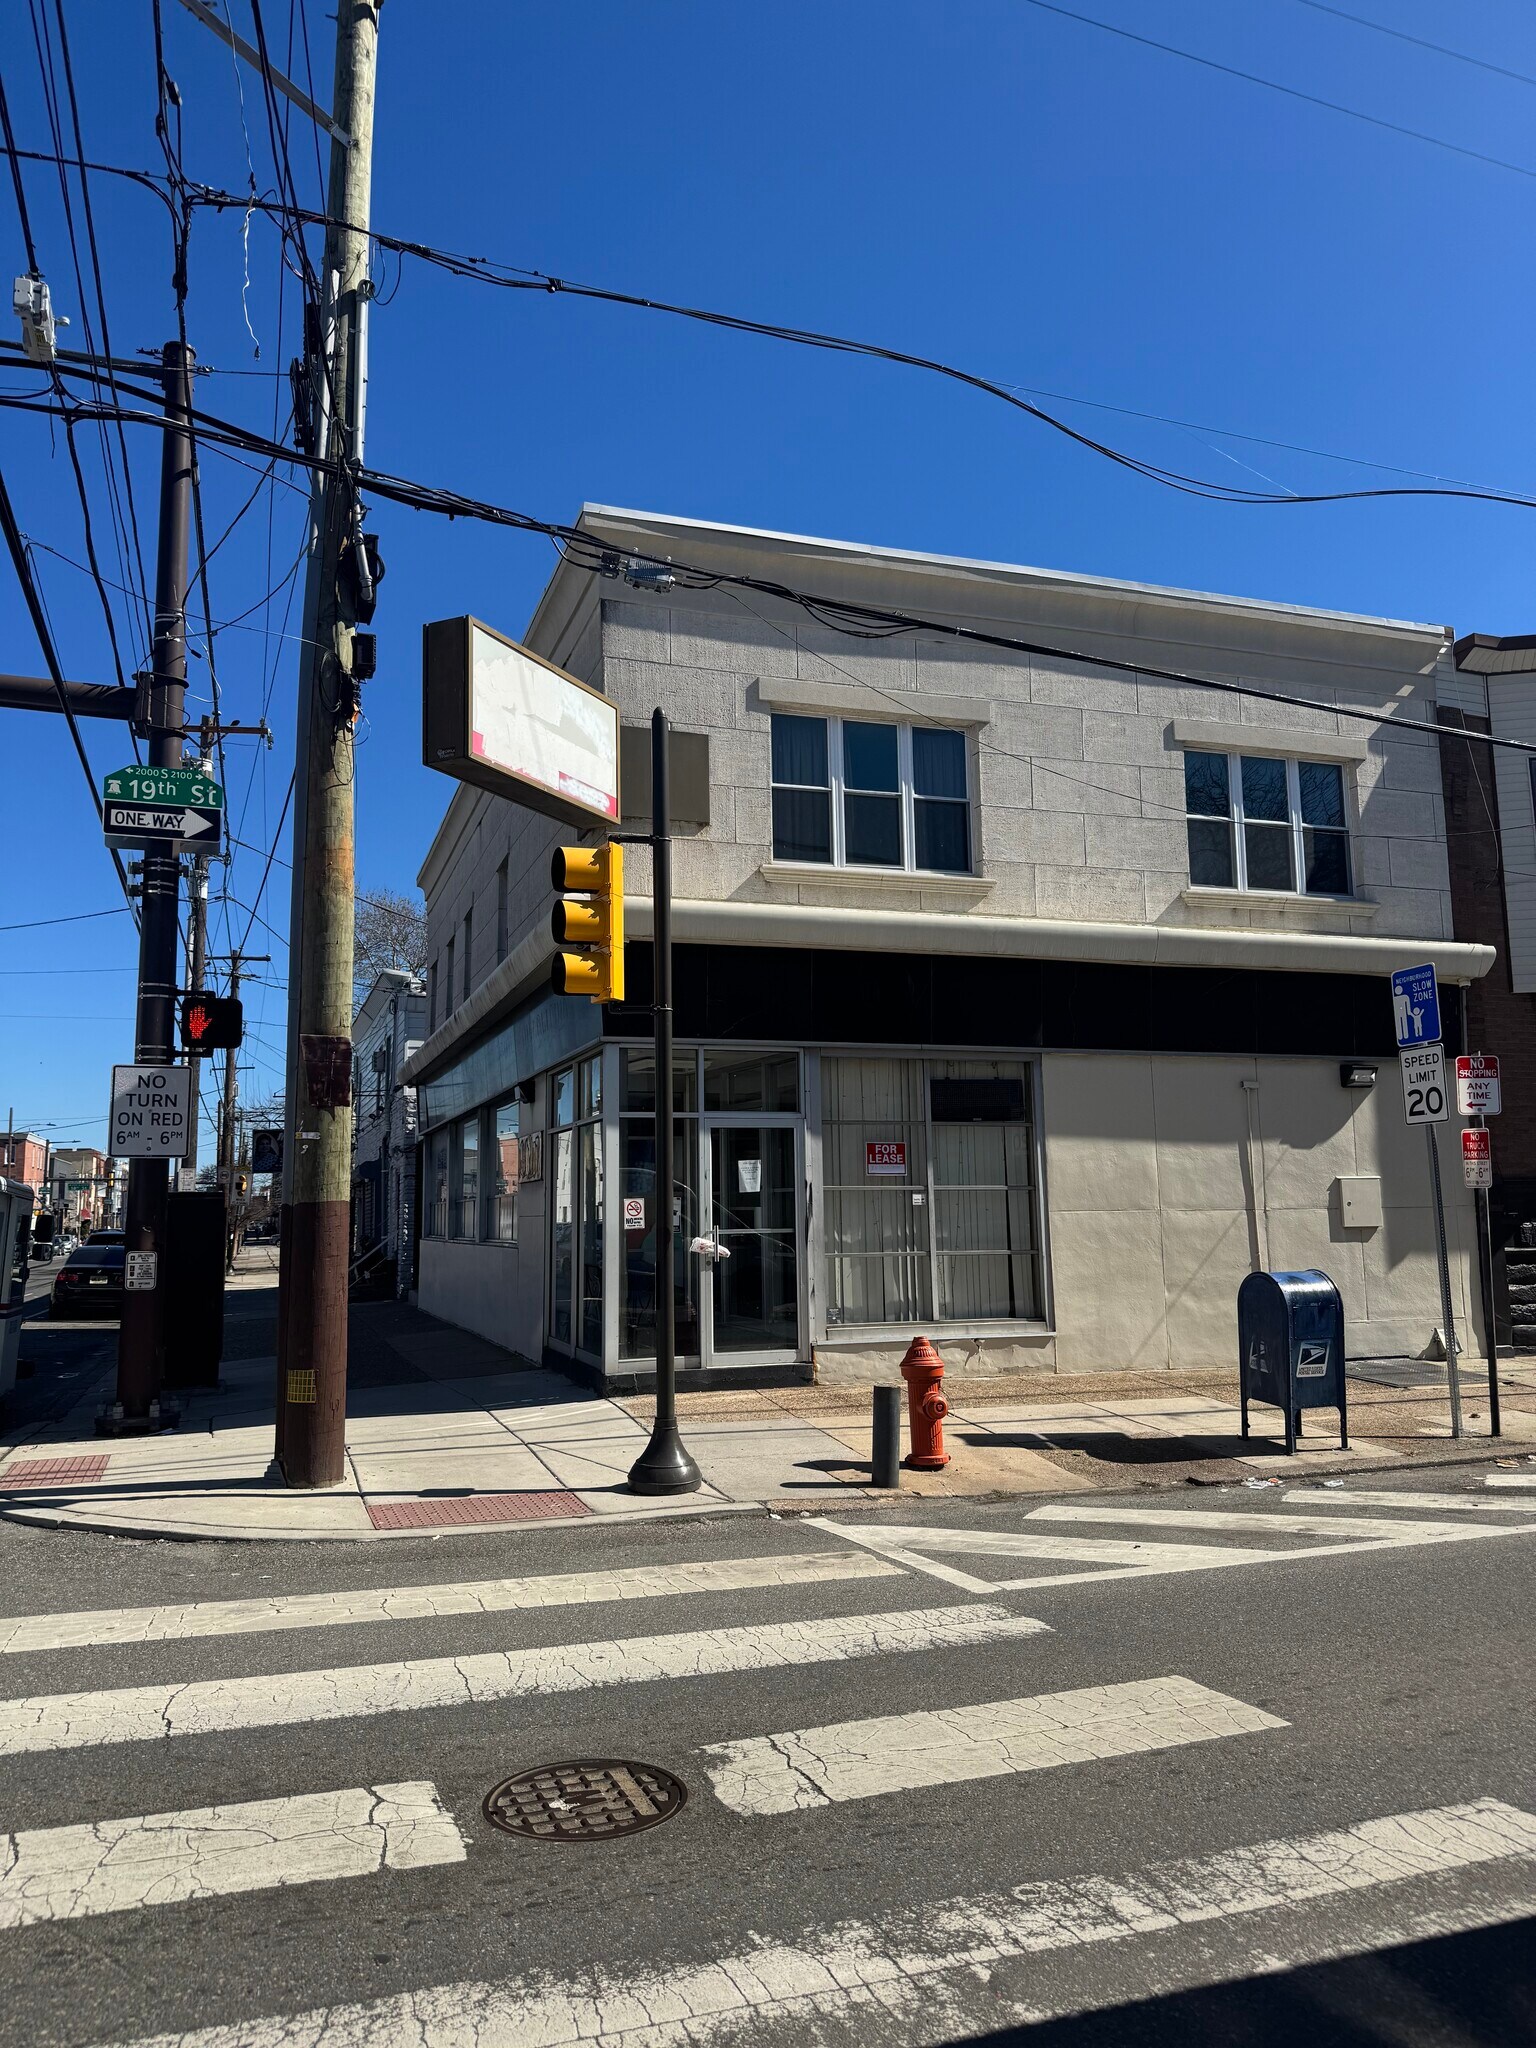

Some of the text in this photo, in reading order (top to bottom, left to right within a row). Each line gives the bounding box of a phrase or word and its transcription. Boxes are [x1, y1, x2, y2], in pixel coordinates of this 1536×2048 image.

[135, 767, 193, 780] 2000 S 2100
[128, 779, 217, 805] 19th St
[114, 810, 185, 829] ONE WAY
[1412, 979, 1433, 992] SLOW
[1413, 989, 1434, 1003] ZONE
[1404, 1052, 1440, 1068] SPEED
[1469, 1058, 1485, 1069] NO
[1408, 1069, 1437, 1084] LIMIT
[1458, 1069, 1497, 1078] STOPPING
[137, 1074, 167, 1089] NO
[1466, 1082, 1490, 1090] ANY
[125, 1093, 178, 1107] TURN
[1406, 1086, 1444, 1117] 20
[1466, 1091, 1492, 1100] TIME
[117, 1111, 183, 1126] ON RED
[116, 1130, 140, 1145] 6AM
[160, 1131, 183, 1145] 6PM
[1470, 1132, 1480, 1141] NO
[875, 1144, 897, 1154] FOR
[1466, 1142, 1485, 1150] TRUCK
[869, 1154, 904, 1163] LEASE
[1464, 1151, 1489, 1159] PARKING
[625, 1217, 634, 1225] NO
